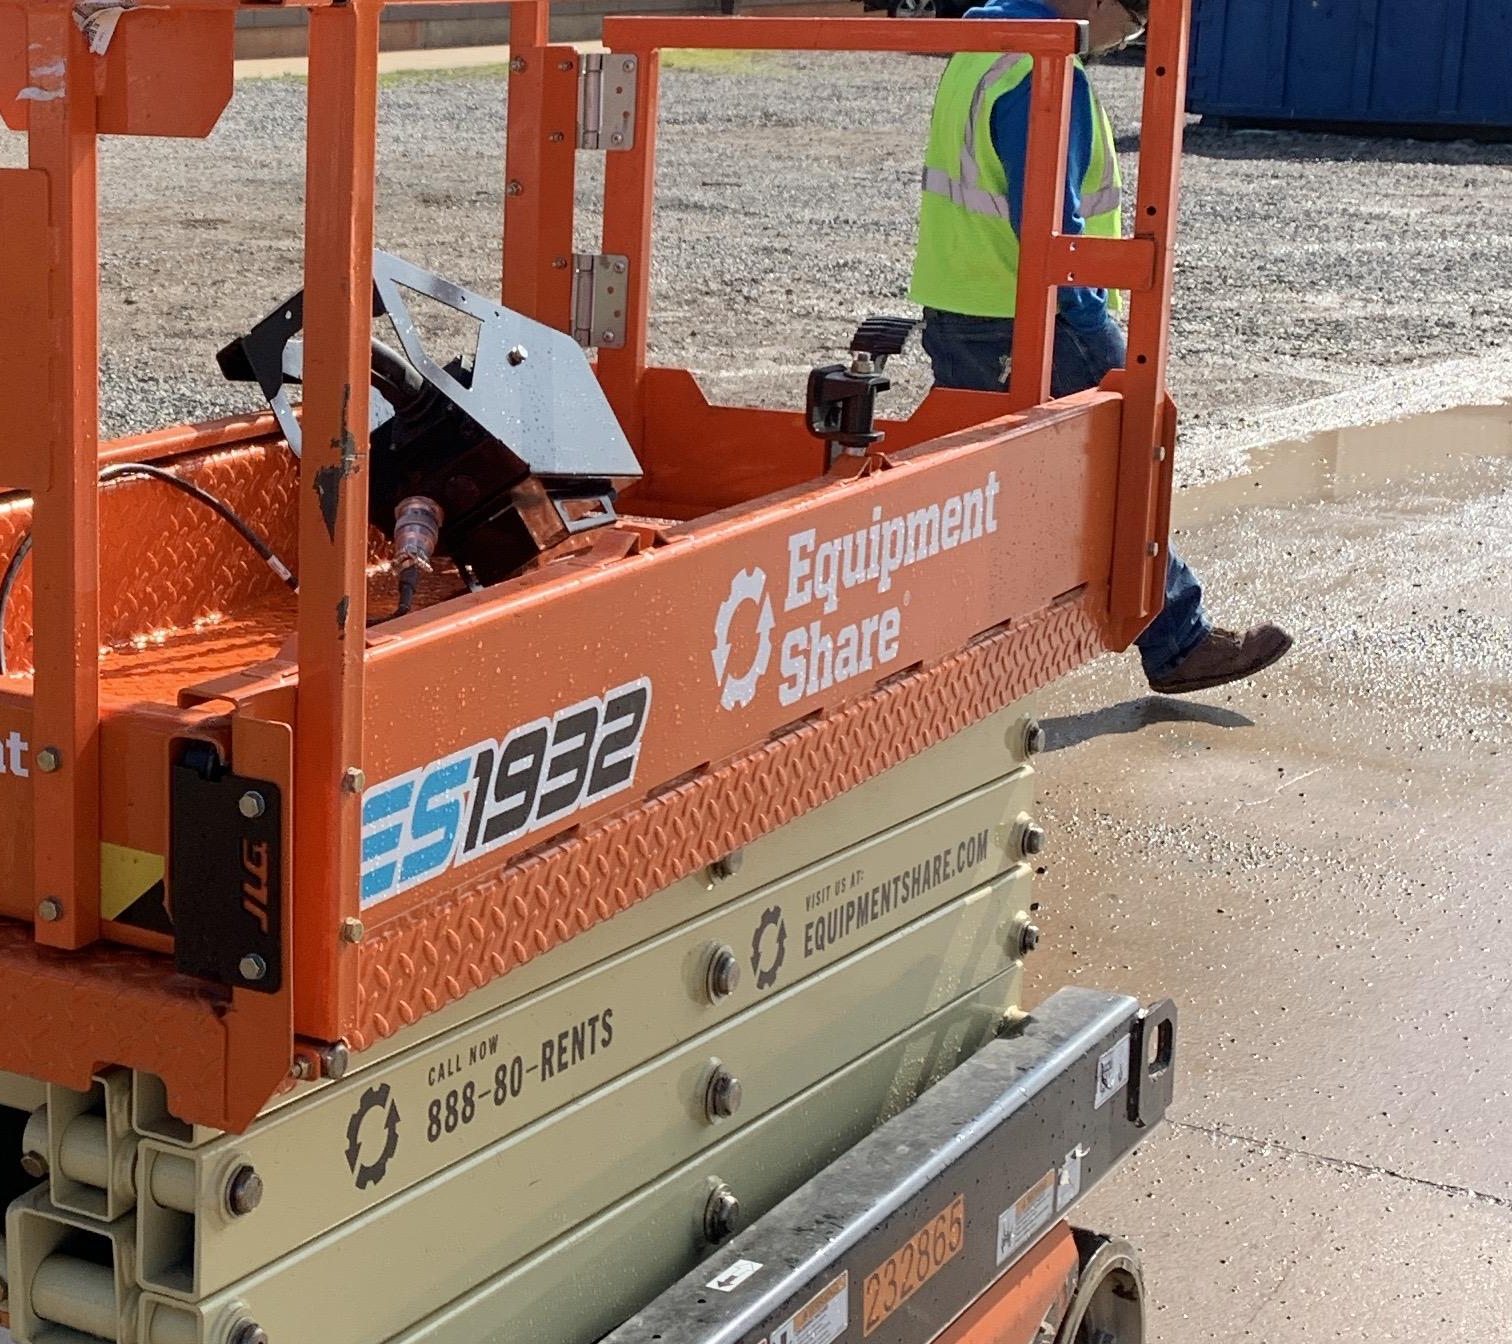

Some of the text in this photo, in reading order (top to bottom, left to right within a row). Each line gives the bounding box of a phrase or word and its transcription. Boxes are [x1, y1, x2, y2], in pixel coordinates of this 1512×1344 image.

[783, 470, 1001, 616] Equipment
[777, 606, 901, 707] Share
[360, 682, 650, 904] ES1932
[242, 836, 269, 936] JLG
[803, 828, 990, 959] EQUIPMENTSHARE.COM
[805, 869, 865, 913] VISIT US AT:
[426, 1007, 614, 1144] 888-80-RENTS
[427, 1033, 500, 1087] CALL NOW
[866, 1199, 963, 1332] 232865
